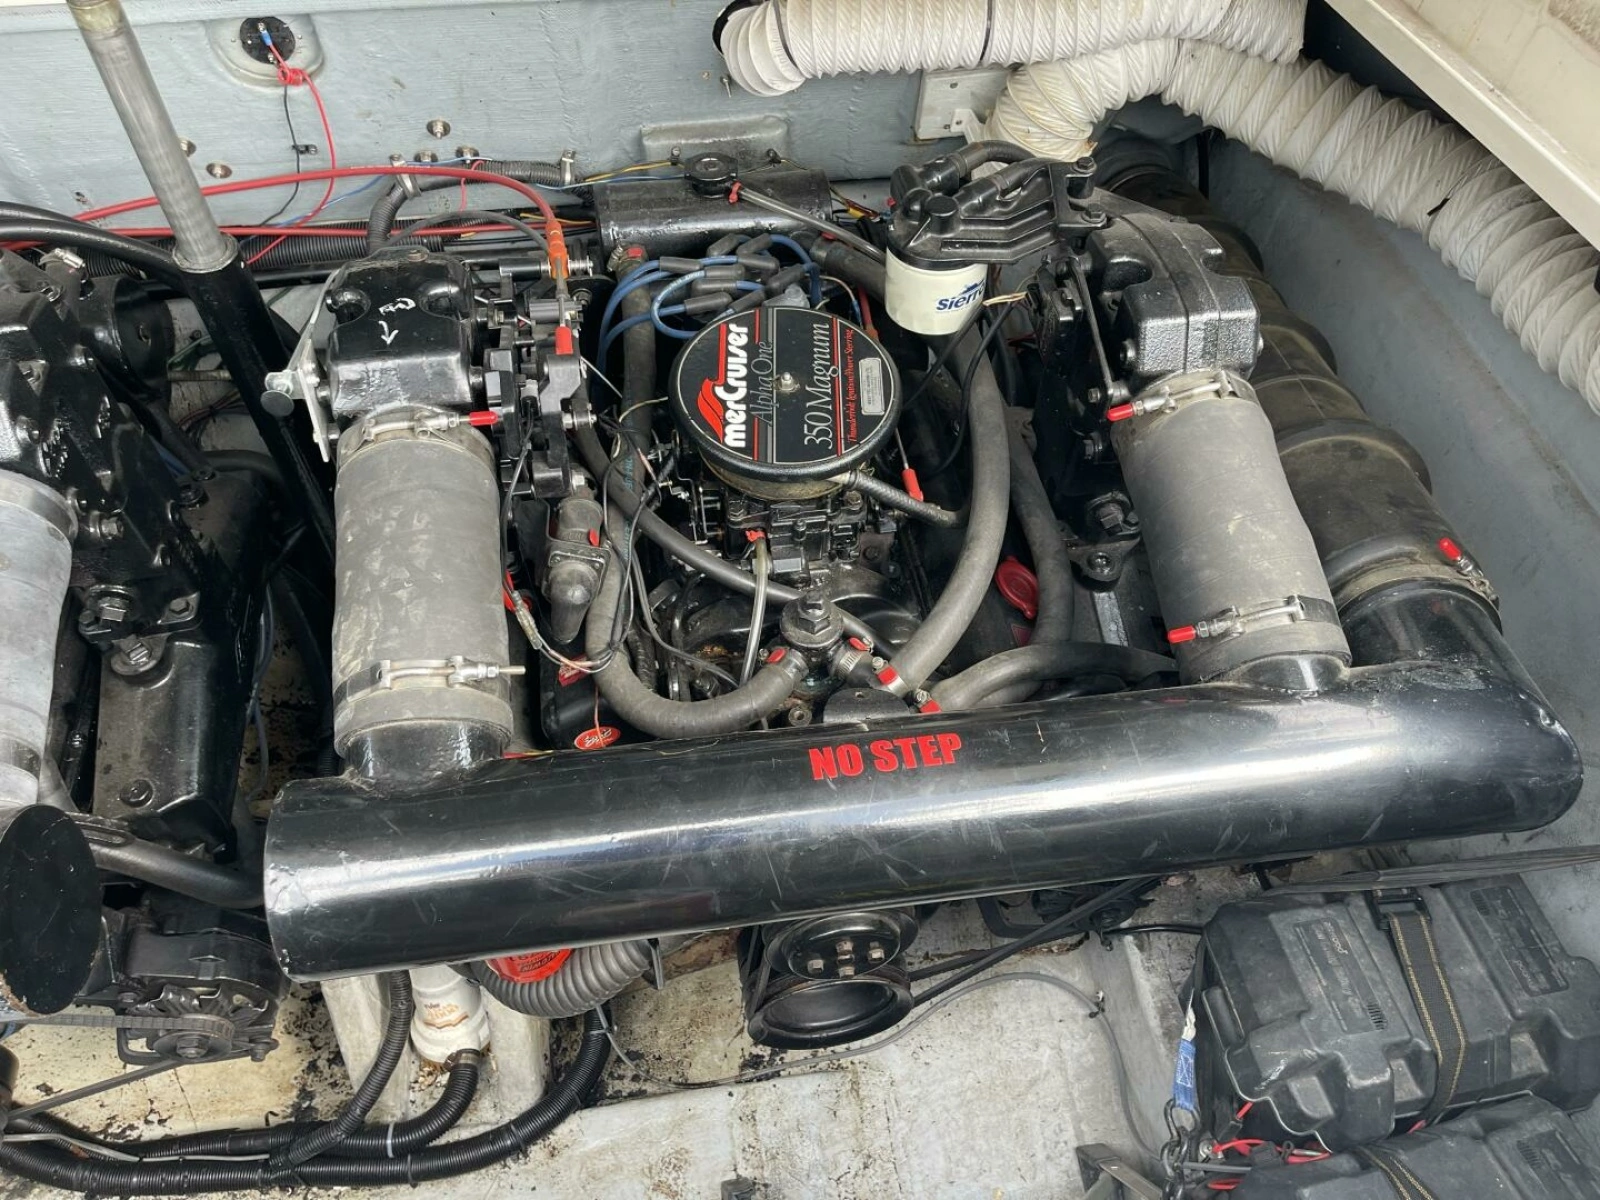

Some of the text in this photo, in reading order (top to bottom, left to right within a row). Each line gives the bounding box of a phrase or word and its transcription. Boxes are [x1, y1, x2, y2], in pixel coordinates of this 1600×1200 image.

[749, 341, 779, 427] Alpha One
[804, 323, 839, 450] 350 Magnum
[809, 733, 962, 781] NO STEP
